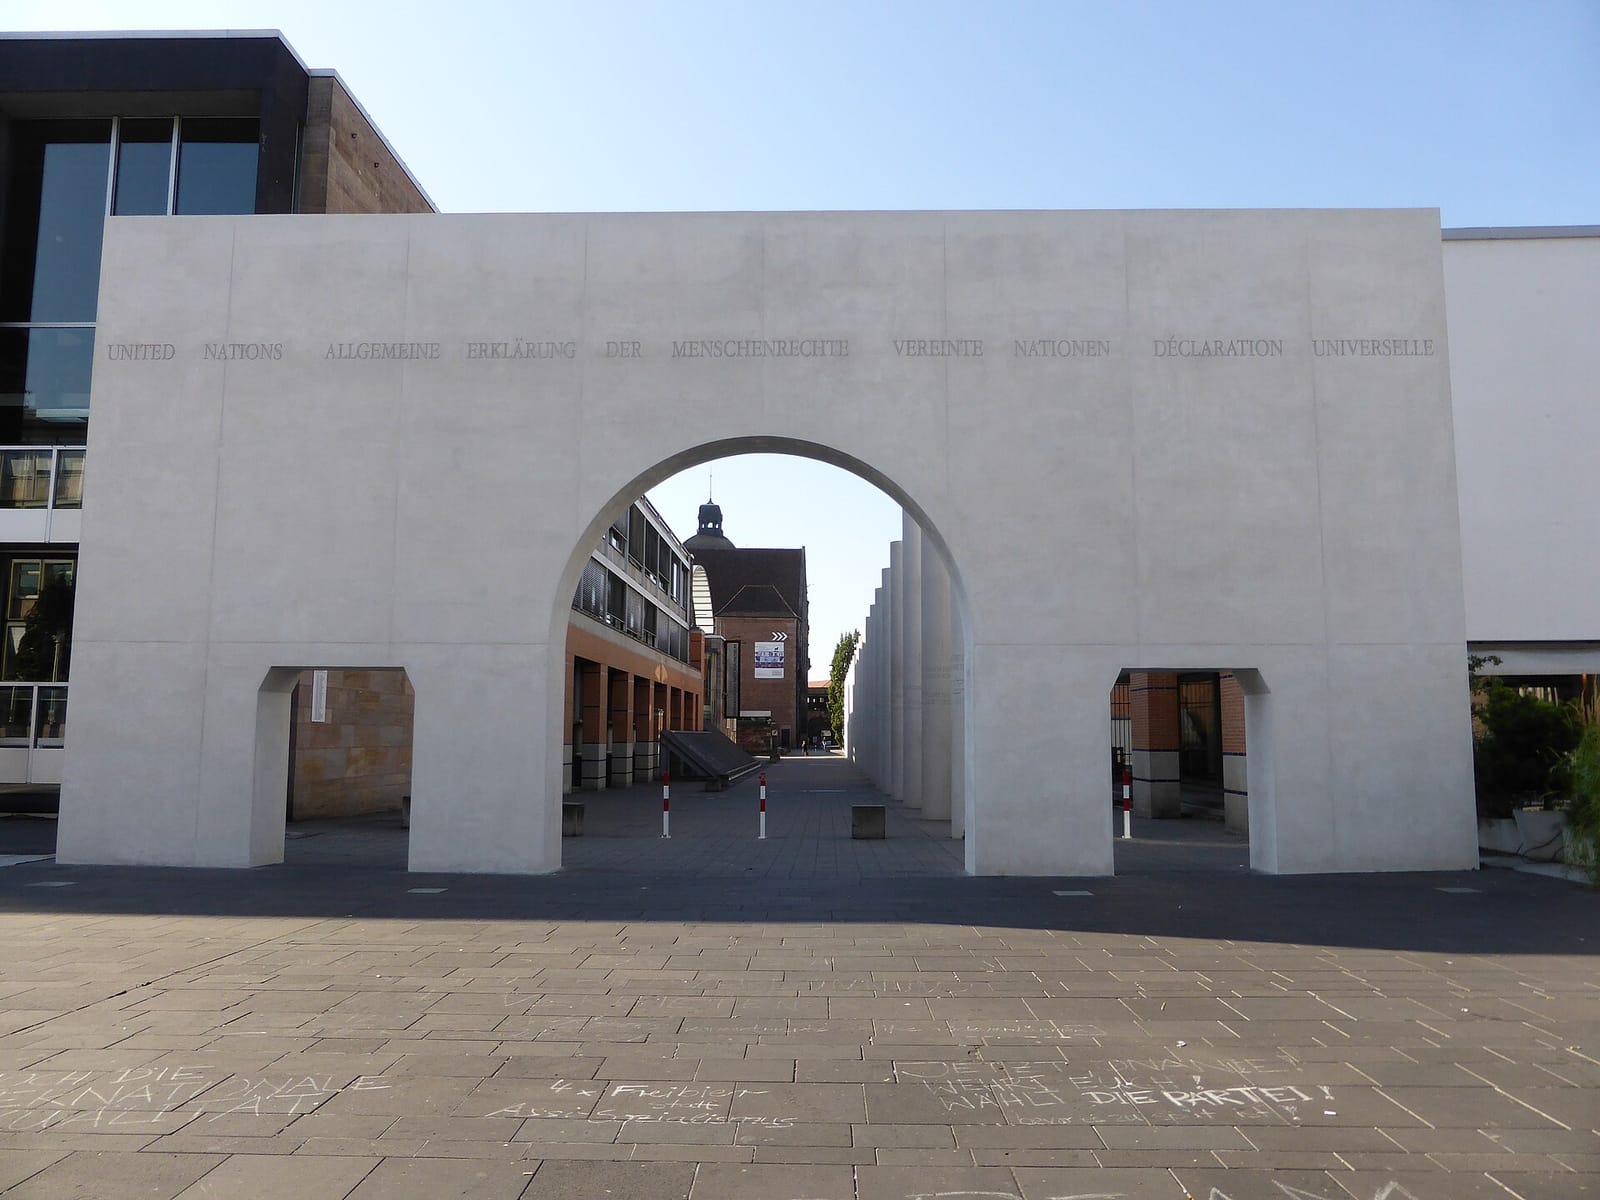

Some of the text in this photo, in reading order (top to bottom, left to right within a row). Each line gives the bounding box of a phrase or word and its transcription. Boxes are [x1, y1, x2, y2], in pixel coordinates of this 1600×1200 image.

[107, 335, 1435, 361] UNITED NATIONS ALLGEMEINE ERKLÄRUNG DER MENSCHENRECHTE VEREINTE NATIONEN DÉCLARATION UNIVERSELLE
[109, 1065, 216, 1084] DIE
[611, 1085, 769, 1098] Freibier
[1081, 1090, 1159, 1105] DIE
